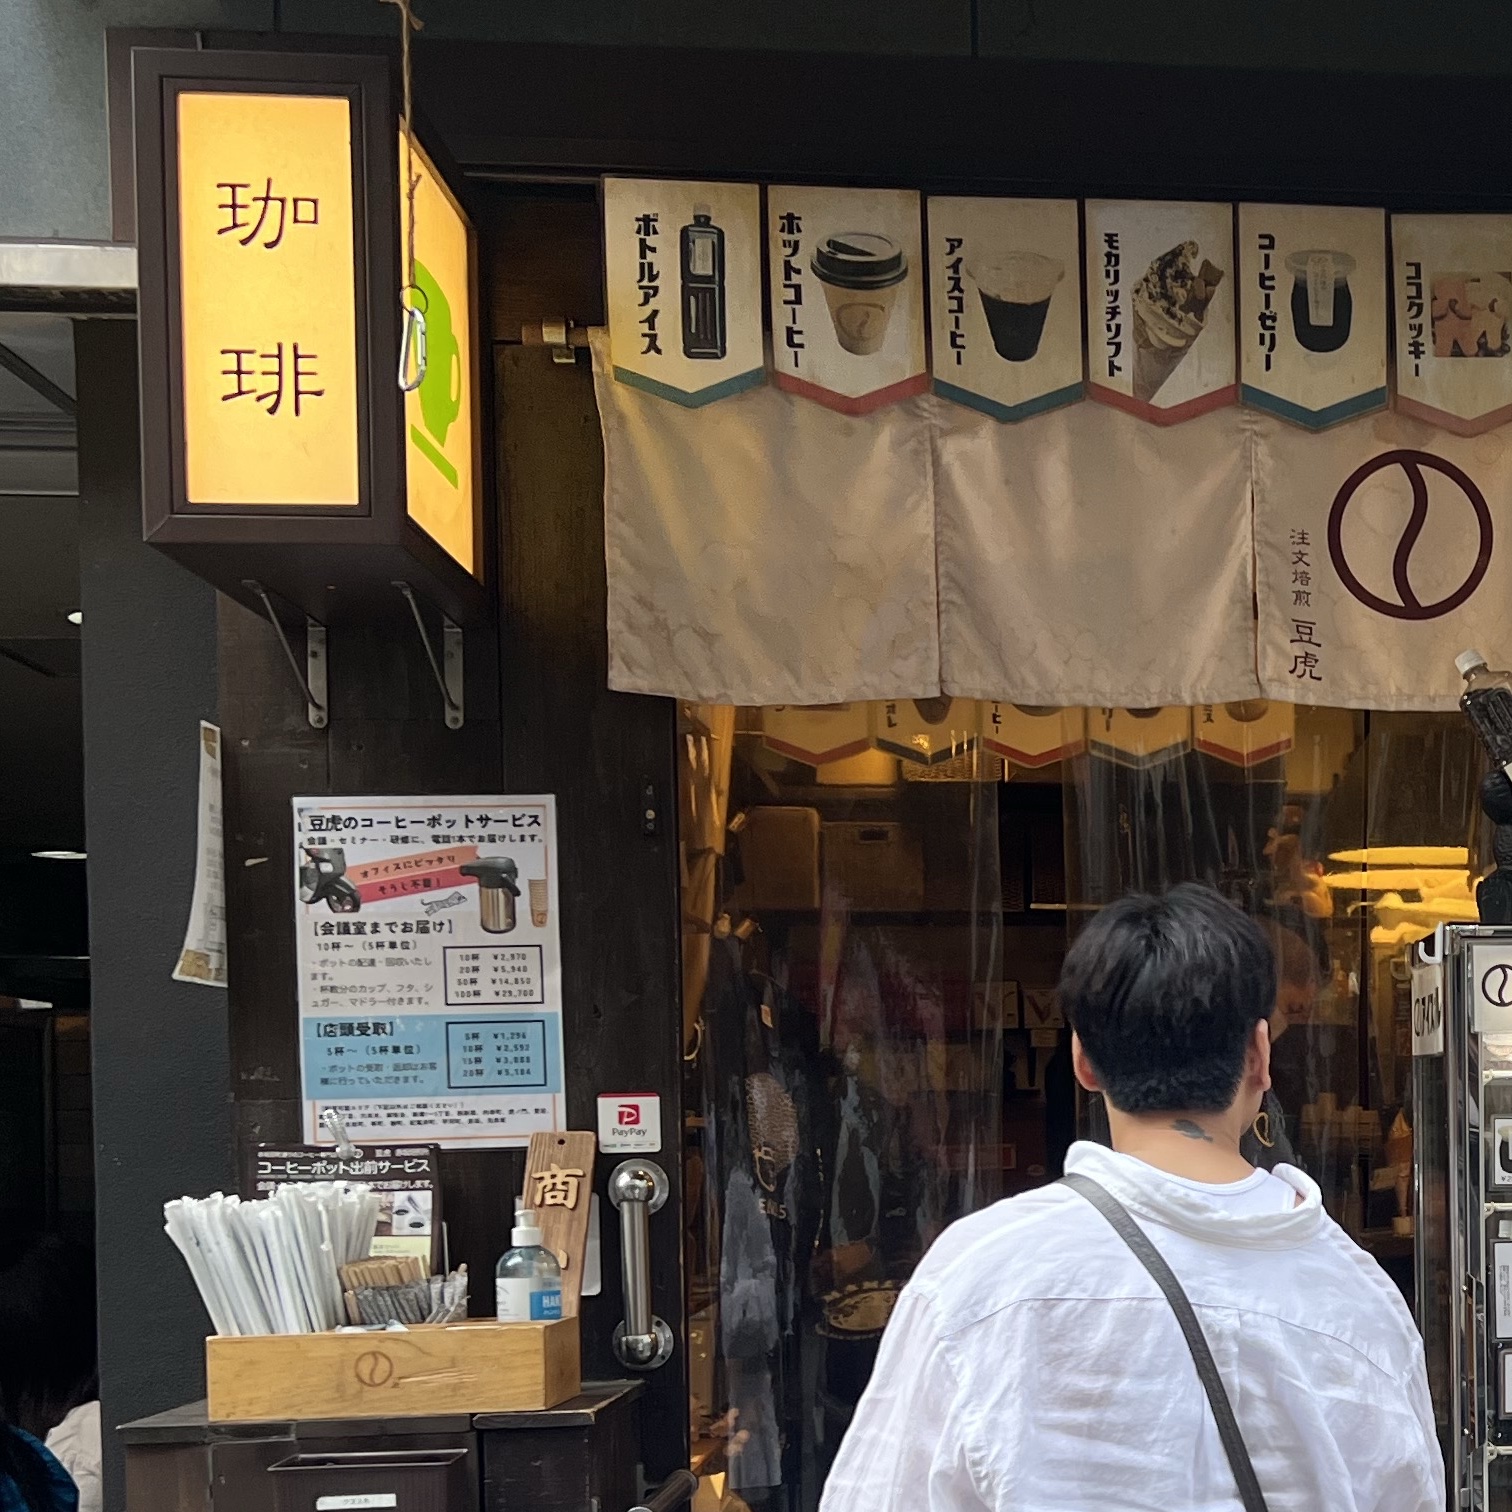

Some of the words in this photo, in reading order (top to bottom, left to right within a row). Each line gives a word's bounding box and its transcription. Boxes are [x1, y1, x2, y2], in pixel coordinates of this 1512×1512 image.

[215, 177, 325, 417] 珈琲
[634, 213, 663, 355] ボトルアイス
[778, 212, 806, 368] ホットコーヒー
[944, 237, 966, 365] アイスコーヒー
[1103, 232, 1122, 377] モカリッチソフト
[1257, 233, 1277, 372] コーヒーゼリー
[1405, 262, 1426, 377] ココクッキー
[1289, 528, 1312, 608] 注文焙煎
[1288, 617, 1323, 681] 豆虎
[307, 813, 542, 832] 豆虎のコーヒーポットサービス
[314, 919, 453, 936] 【会議室までお届け】
[317, 1021, 394, 1038] 【店頭受取】
[257, 1159, 431, 1176] コーヒーポット出前サービス
[612, 1127, 648, 1137] PayPay
[531, 1163, 587, 1210] 商
